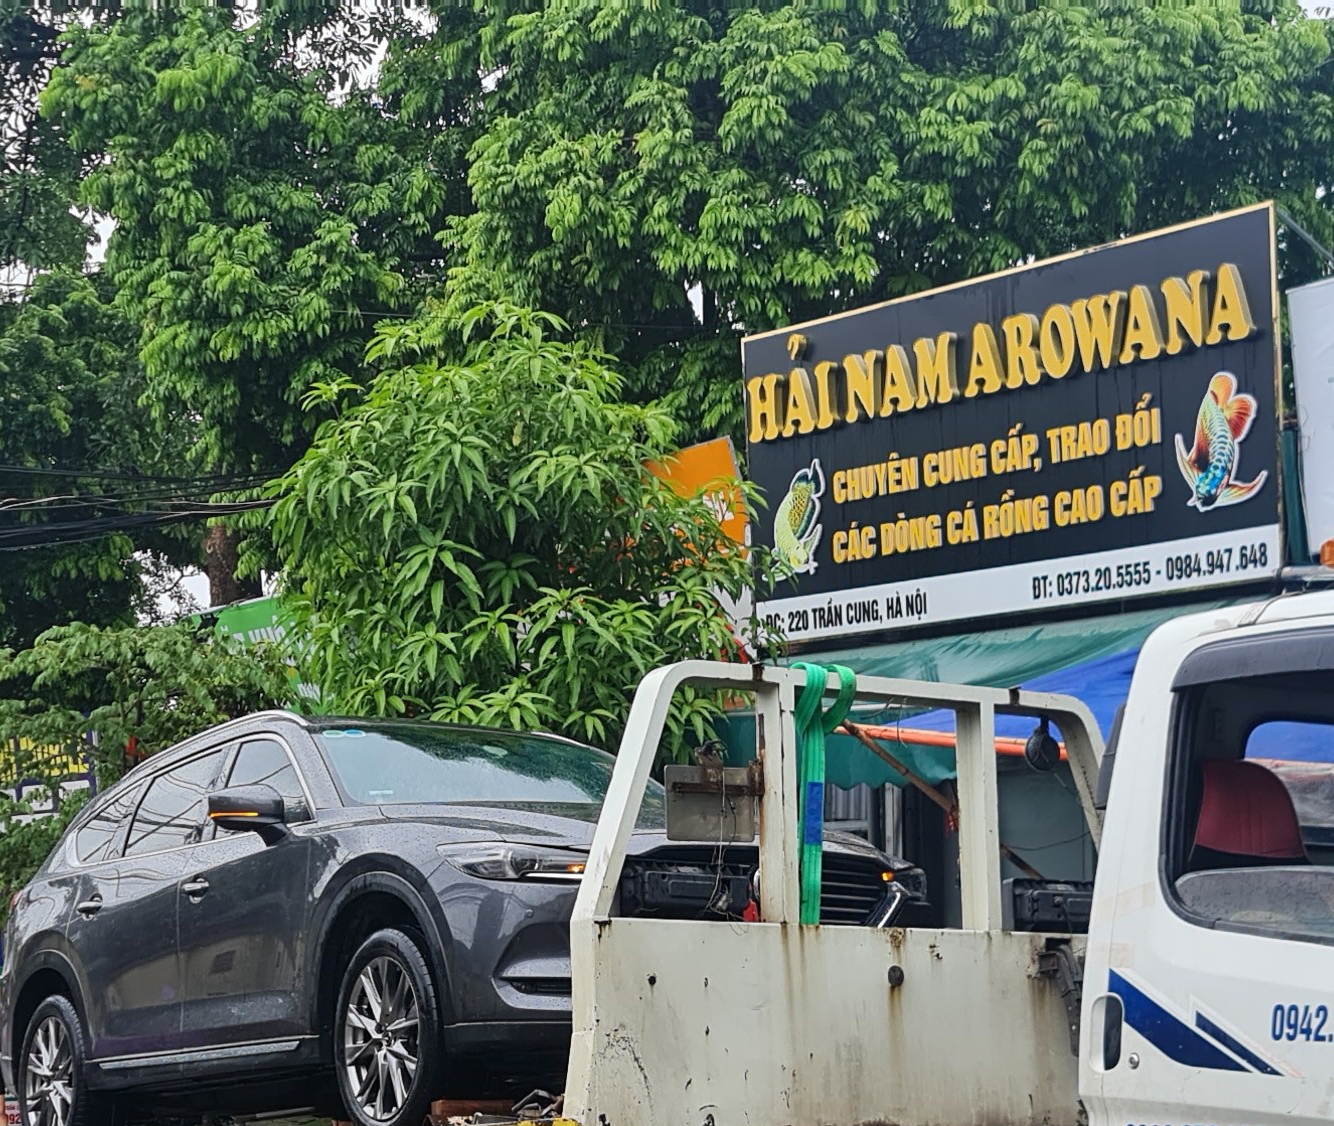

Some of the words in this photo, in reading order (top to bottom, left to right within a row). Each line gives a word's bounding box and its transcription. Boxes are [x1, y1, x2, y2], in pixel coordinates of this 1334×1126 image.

[747, 334, 841, 443] HẢI
[843, 331, 961, 424] NAM
[963, 263, 1257, 401] AROWANA
[832, 448, 919, 505] CHUYÊN
[923, 442, 986, 491] CUNG
[989, 421, 1043, 474] CẤP,
[1046, 416, 1110, 465] TRAO
[1114, 390, 1162, 452] ĐỔI
[831, 520, 877, 564] CÁC
[880, 501, 943, 559] DÒNG
[946, 499, 977, 546] CÁ
[982, 486, 1049, 540] RỒNG
[1054, 484, 1106, 527] CAO
[1109, 465, 1163, 519] CẤP
[787, 608, 809, 634] 220
[846, 598, 884, 626] CUNG,
[886, 590, 904, 620] HÀ
[905, 586, 928, 622] NỘI
[1056, 560, 1153, 598] 0373.20.5555
[1165, 542, 1269, 582] 0984.947.648
